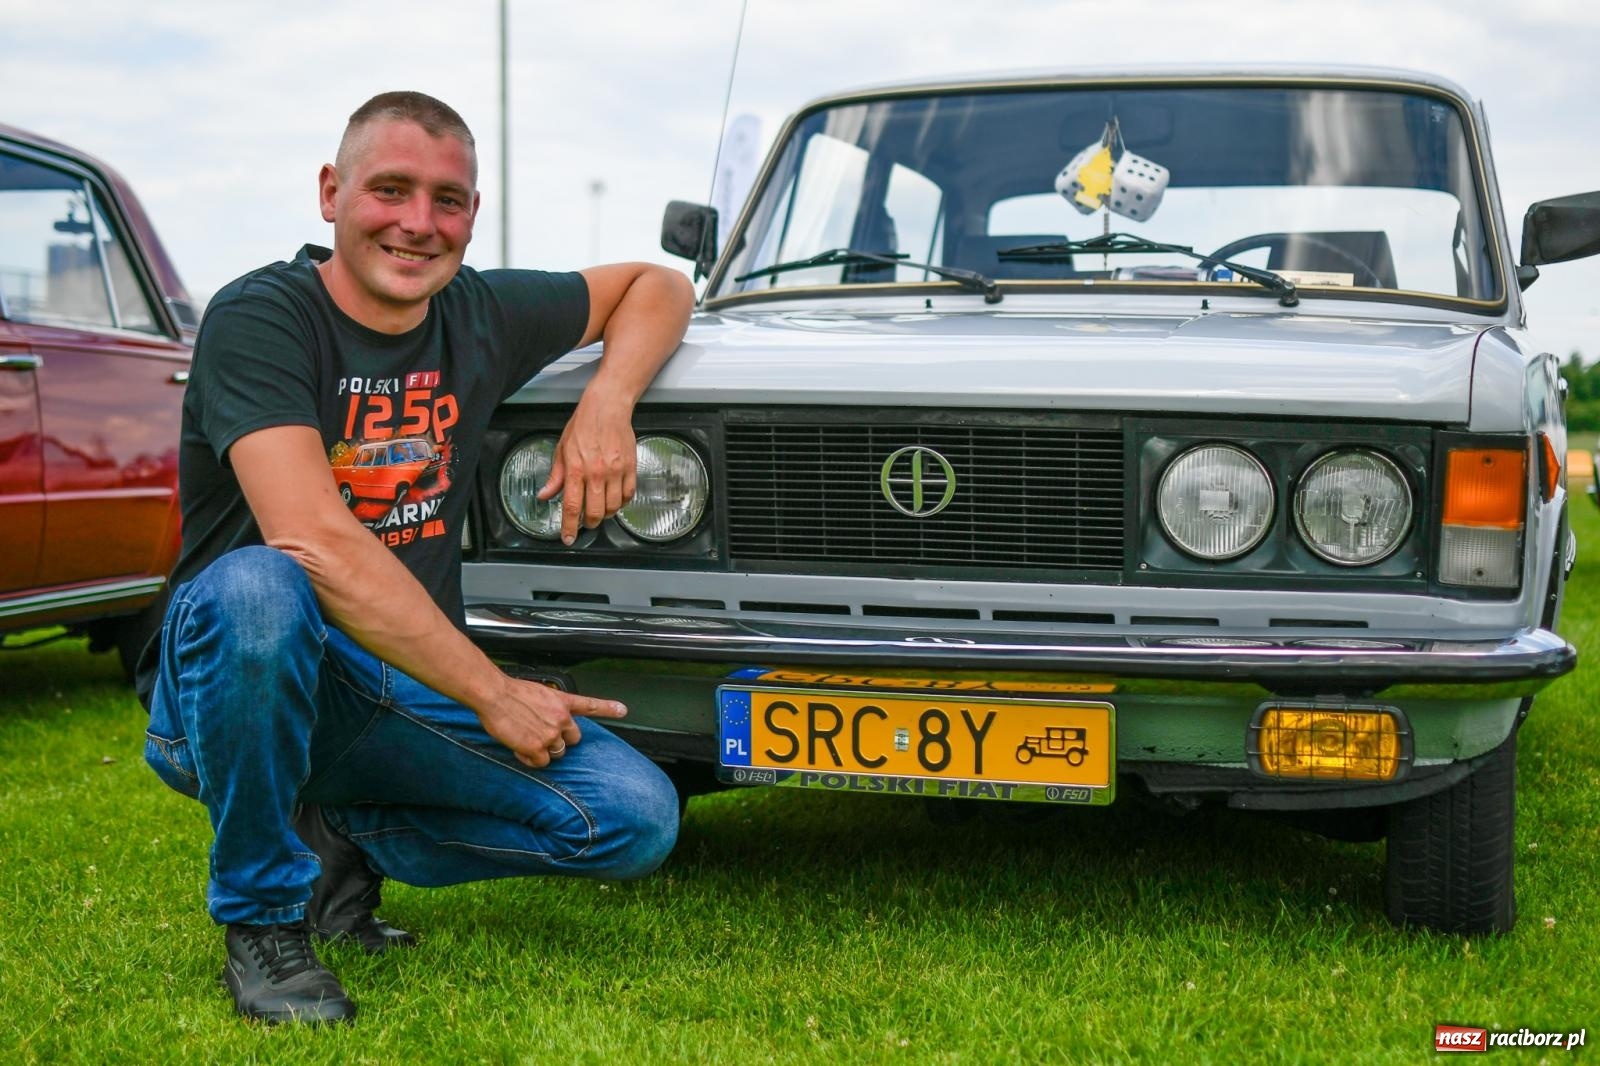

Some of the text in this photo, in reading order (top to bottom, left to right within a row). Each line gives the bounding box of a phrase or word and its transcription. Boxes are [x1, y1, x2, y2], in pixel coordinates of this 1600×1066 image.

[338, 376, 399, 396] POLSKI
[726, 738, 748, 756] PL
[764, 700, 998, 775] SRC 8Y
[800, 772, 1019, 800] POLSKI FIAT
